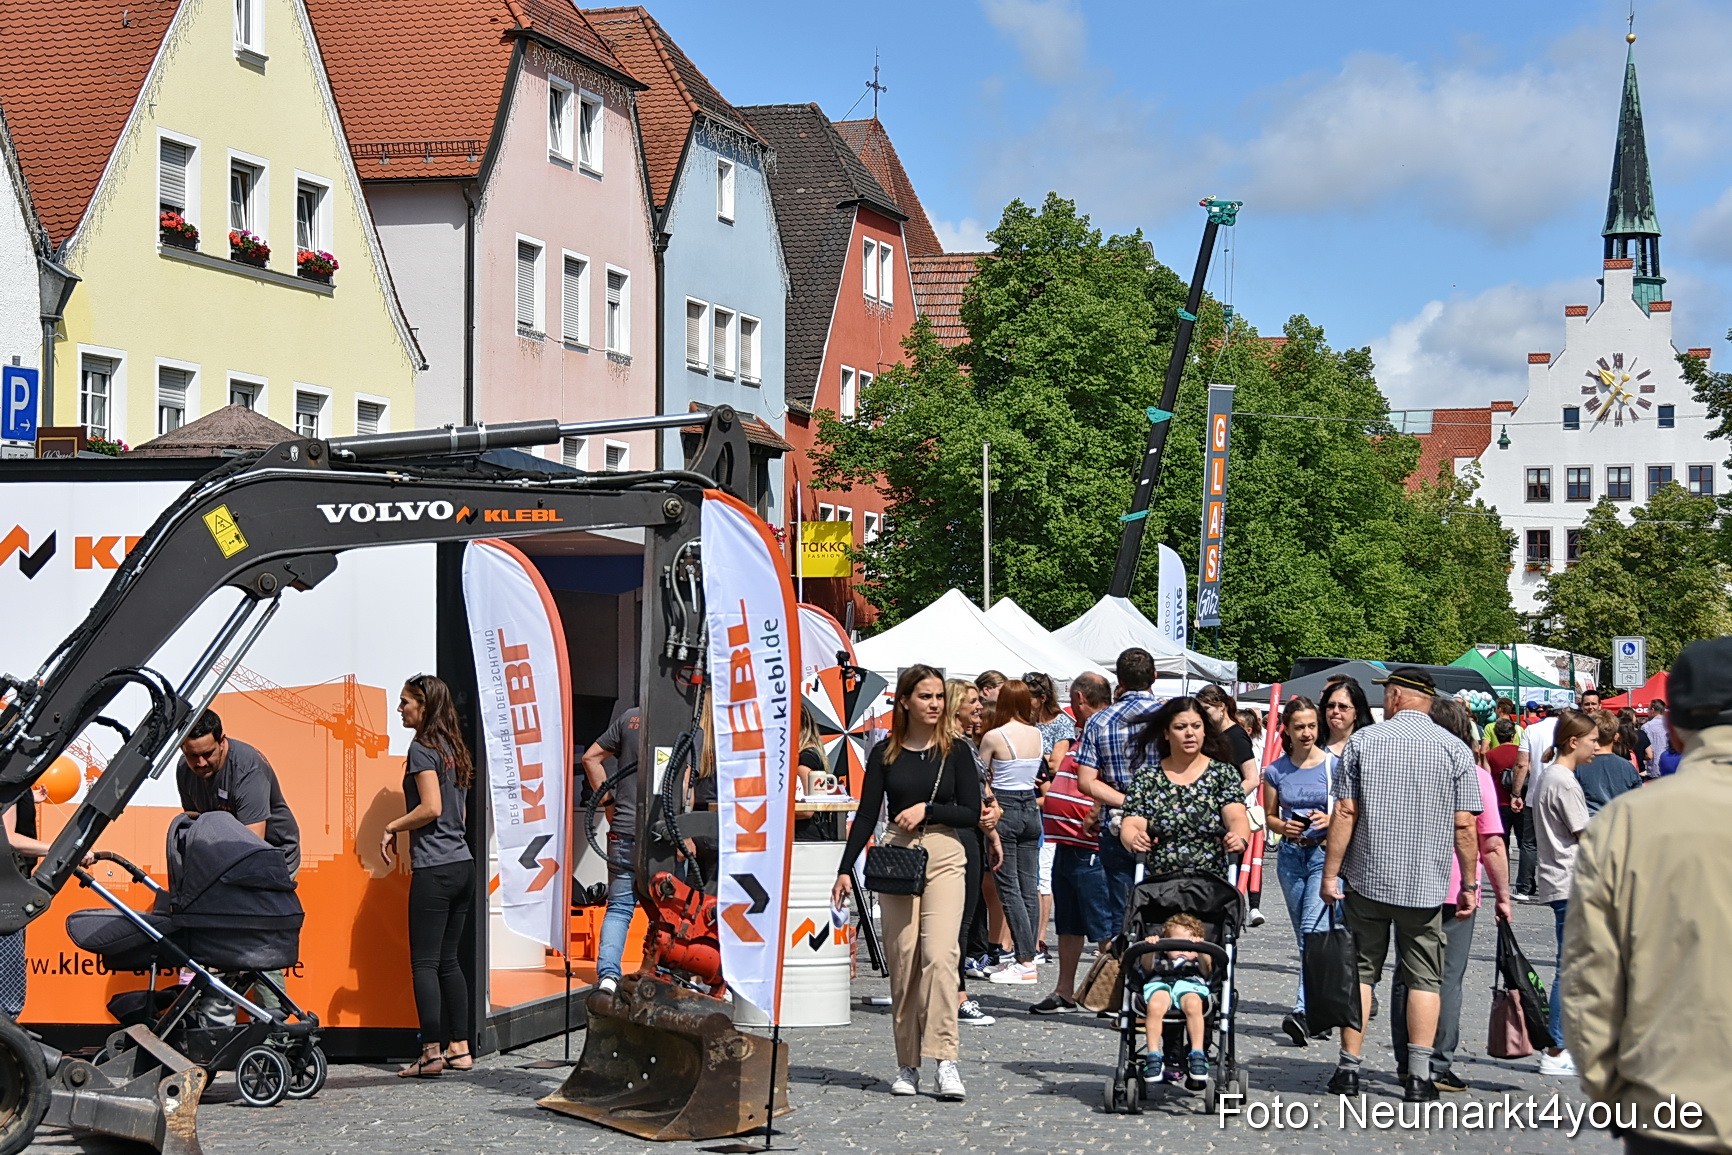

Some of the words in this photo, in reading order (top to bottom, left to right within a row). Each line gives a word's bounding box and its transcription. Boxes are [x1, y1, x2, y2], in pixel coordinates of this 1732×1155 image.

[9, 376, 30, 431] P
[316, 500, 454, 523] VOLVO
[484, 509, 563, 522] KLEBL
[1207, 417, 1225, 579] GLAS
[727, 599, 768, 853] KLEBL
[760, 618, 787, 792] www.klebl.de
